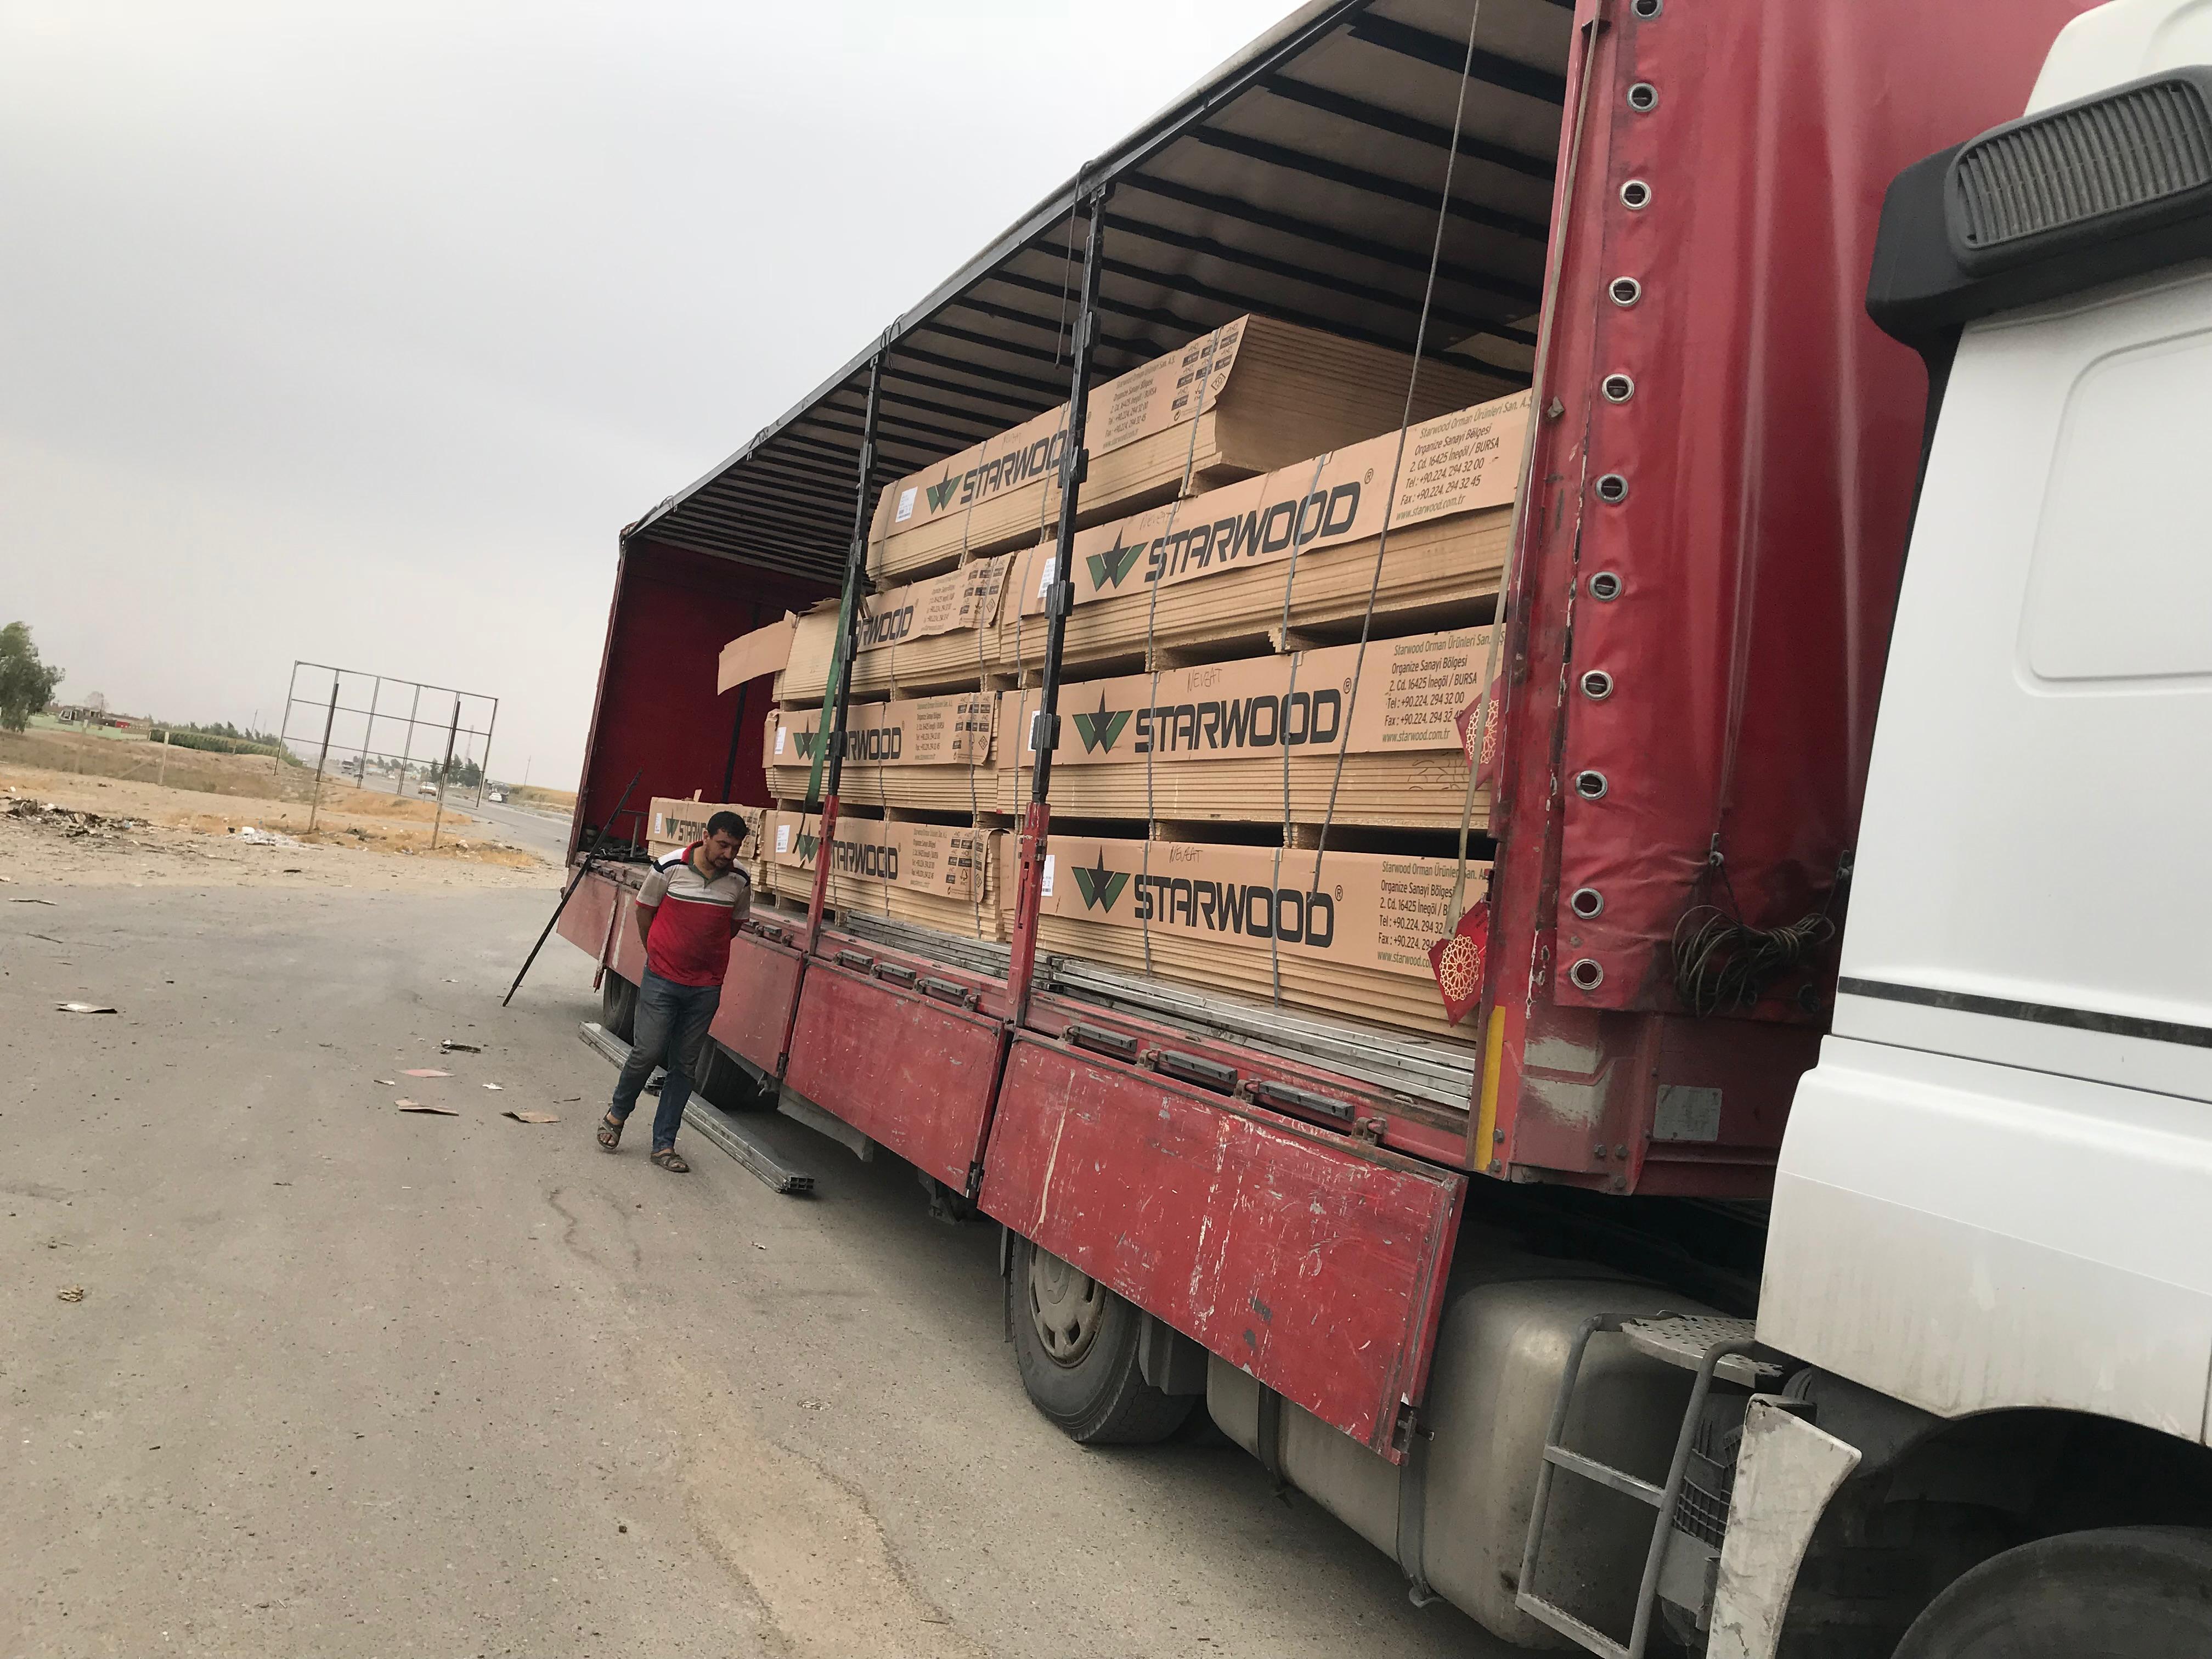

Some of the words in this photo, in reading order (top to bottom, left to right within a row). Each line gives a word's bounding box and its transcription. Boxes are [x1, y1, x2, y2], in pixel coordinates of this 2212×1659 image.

[1420, 422, 1449, 439] Starwood
[1451, 415, 1472, 429] Orman
[1474, 405, 1503, 421] Ürünleri
[1504, 401, 1517, 413] San.
[1414, 440, 1443, 456] Organize
[1443, 434, 1466, 448] Sanayi
[1465, 423, 1493, 439] Bölgesi
[1409, 461, 1416, 472] 2.
[1418, 458, 1426, 471] Cd.
[1429, 452, 1448, 466] 16425
[1448, 445, 1470, 461] İnegöl
[1475, 437, 1499, 453] BURSA
[960, 430, 1068, 505] STARWOO
[1448, 465, 1461, 477] 294
[1462, 460, 1472, 474] 32
[1473, 457, 1485, 470] 00
[1445, 481, 1459, 495] 294
[1459, 478, 1470, 491] 32
[1470, 475, 1482, 488] 45
[1396, 494, 1466, 521] www.starwood.com.tr
[1144, 481, 1361, 583] STARWOOD
[1394, 642, 1424, 656] Starwood
[1425, 640, 1446, 652] Orman
[1448, 634, 1475, 650] Ürünleri
[1476, 634, 1491, 645] San.
[1392, 661, 1419, 676] Organize
[1420, 658, 1442, 673] Sanayi
[1442, 655, 1468, 669] Bölgesi
[1389, 680, 1395, 692] 2.
[1397, 680, 1407, 691] Cd.
[1408, 677, 1427, 689] 16425
[1427, 674, 1448, 690] İnegöl
[1448, 675, 1454, 687] /
[1454, 672, 1477, 686] BURSA
[1401, 695, 1428, 708] +90.224.
[1430, 693, 1443, 706] 294
[1444, 692, 1454, 705] 32
[1454, 691, 1465, 704] 00
[1135, 689, 1341, 753] STARWOOD
[1400, 712, 1427, 725] +90.224.
[1429, 710, 1442, 723] 294
[1443, 710, 1453, 723] 32
[1383, 727, 1451, 742] www.starwood.com.tr
[1382, 861, 1411, 874] Starwood
[1412, 864, 1433, 876] Orman
[1381, 879, 1408, 894] Organize
[1409, 882, 1430, 898] Sanayi
[1135, 874, 1334, 948] STARWOOD
[1380, 897, 1385, 909] 2.
[1387, 898, 1397, 911] Cd.
[1398, 899, 1417, 912] 16425
[1418, 899, 1437, 917] İnegöl
[1437, 902, 1442, 916] /
[1393, 917, 1420, 931] +90.224.
[1421, 920, 1434, 933] 294
[1434, 922, 1443, 934] 32
[1393, 935, 1420, 950] +90.224.
